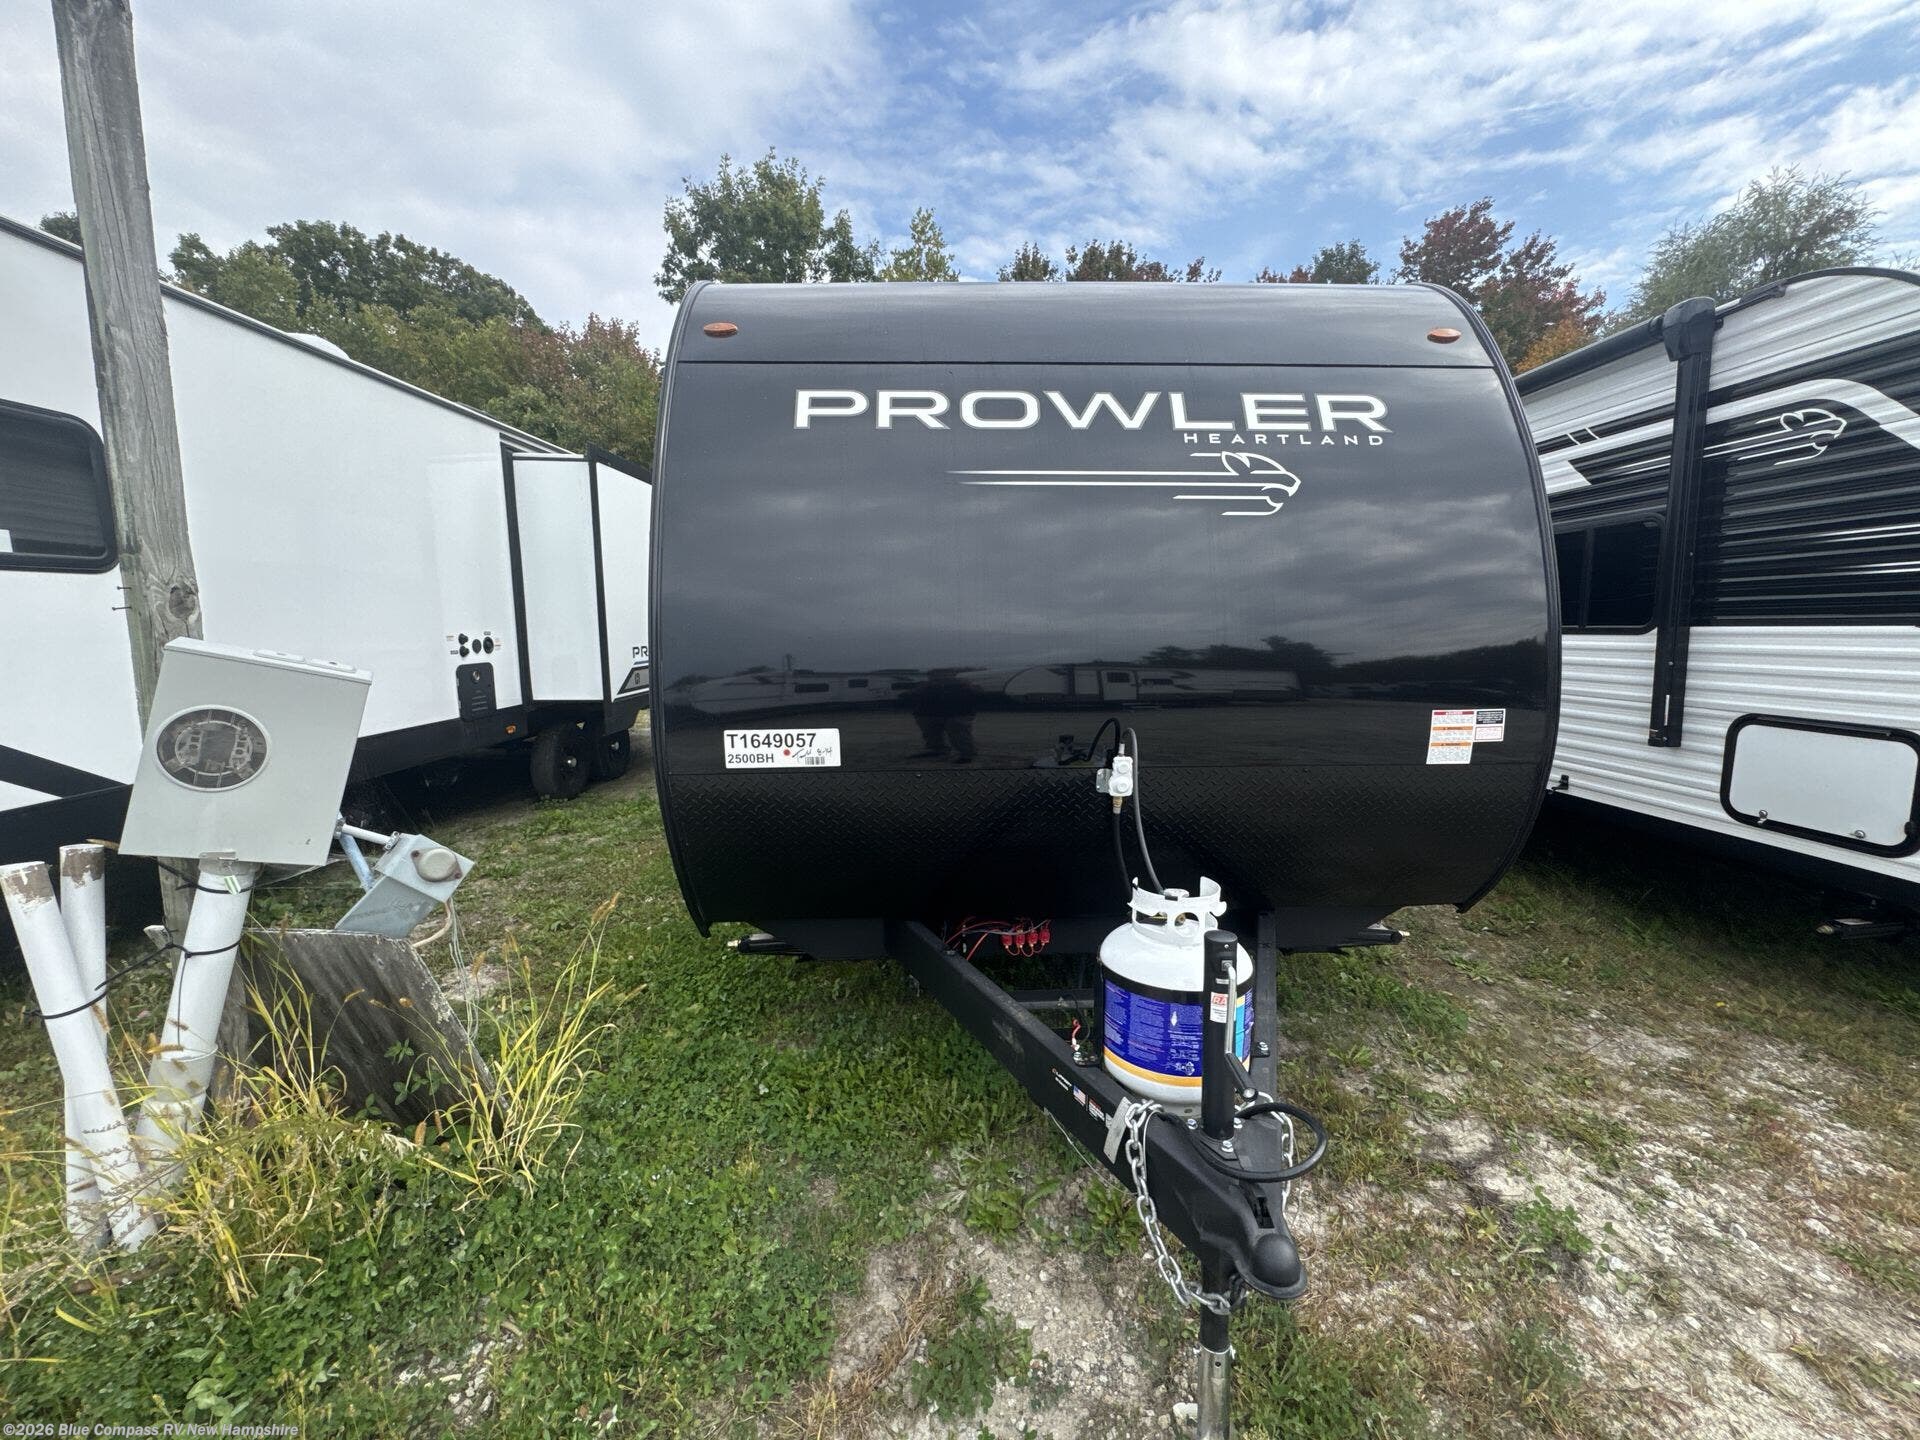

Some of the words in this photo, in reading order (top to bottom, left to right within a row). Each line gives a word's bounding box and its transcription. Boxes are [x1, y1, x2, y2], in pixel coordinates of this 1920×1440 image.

[794, 389, 1392, 432] PROWLER
[1184, 433, 1384, 446] HEARTLAND
[726, 732, 817, 749] T1649057
[727, 753, 775, 764] 2500BH
